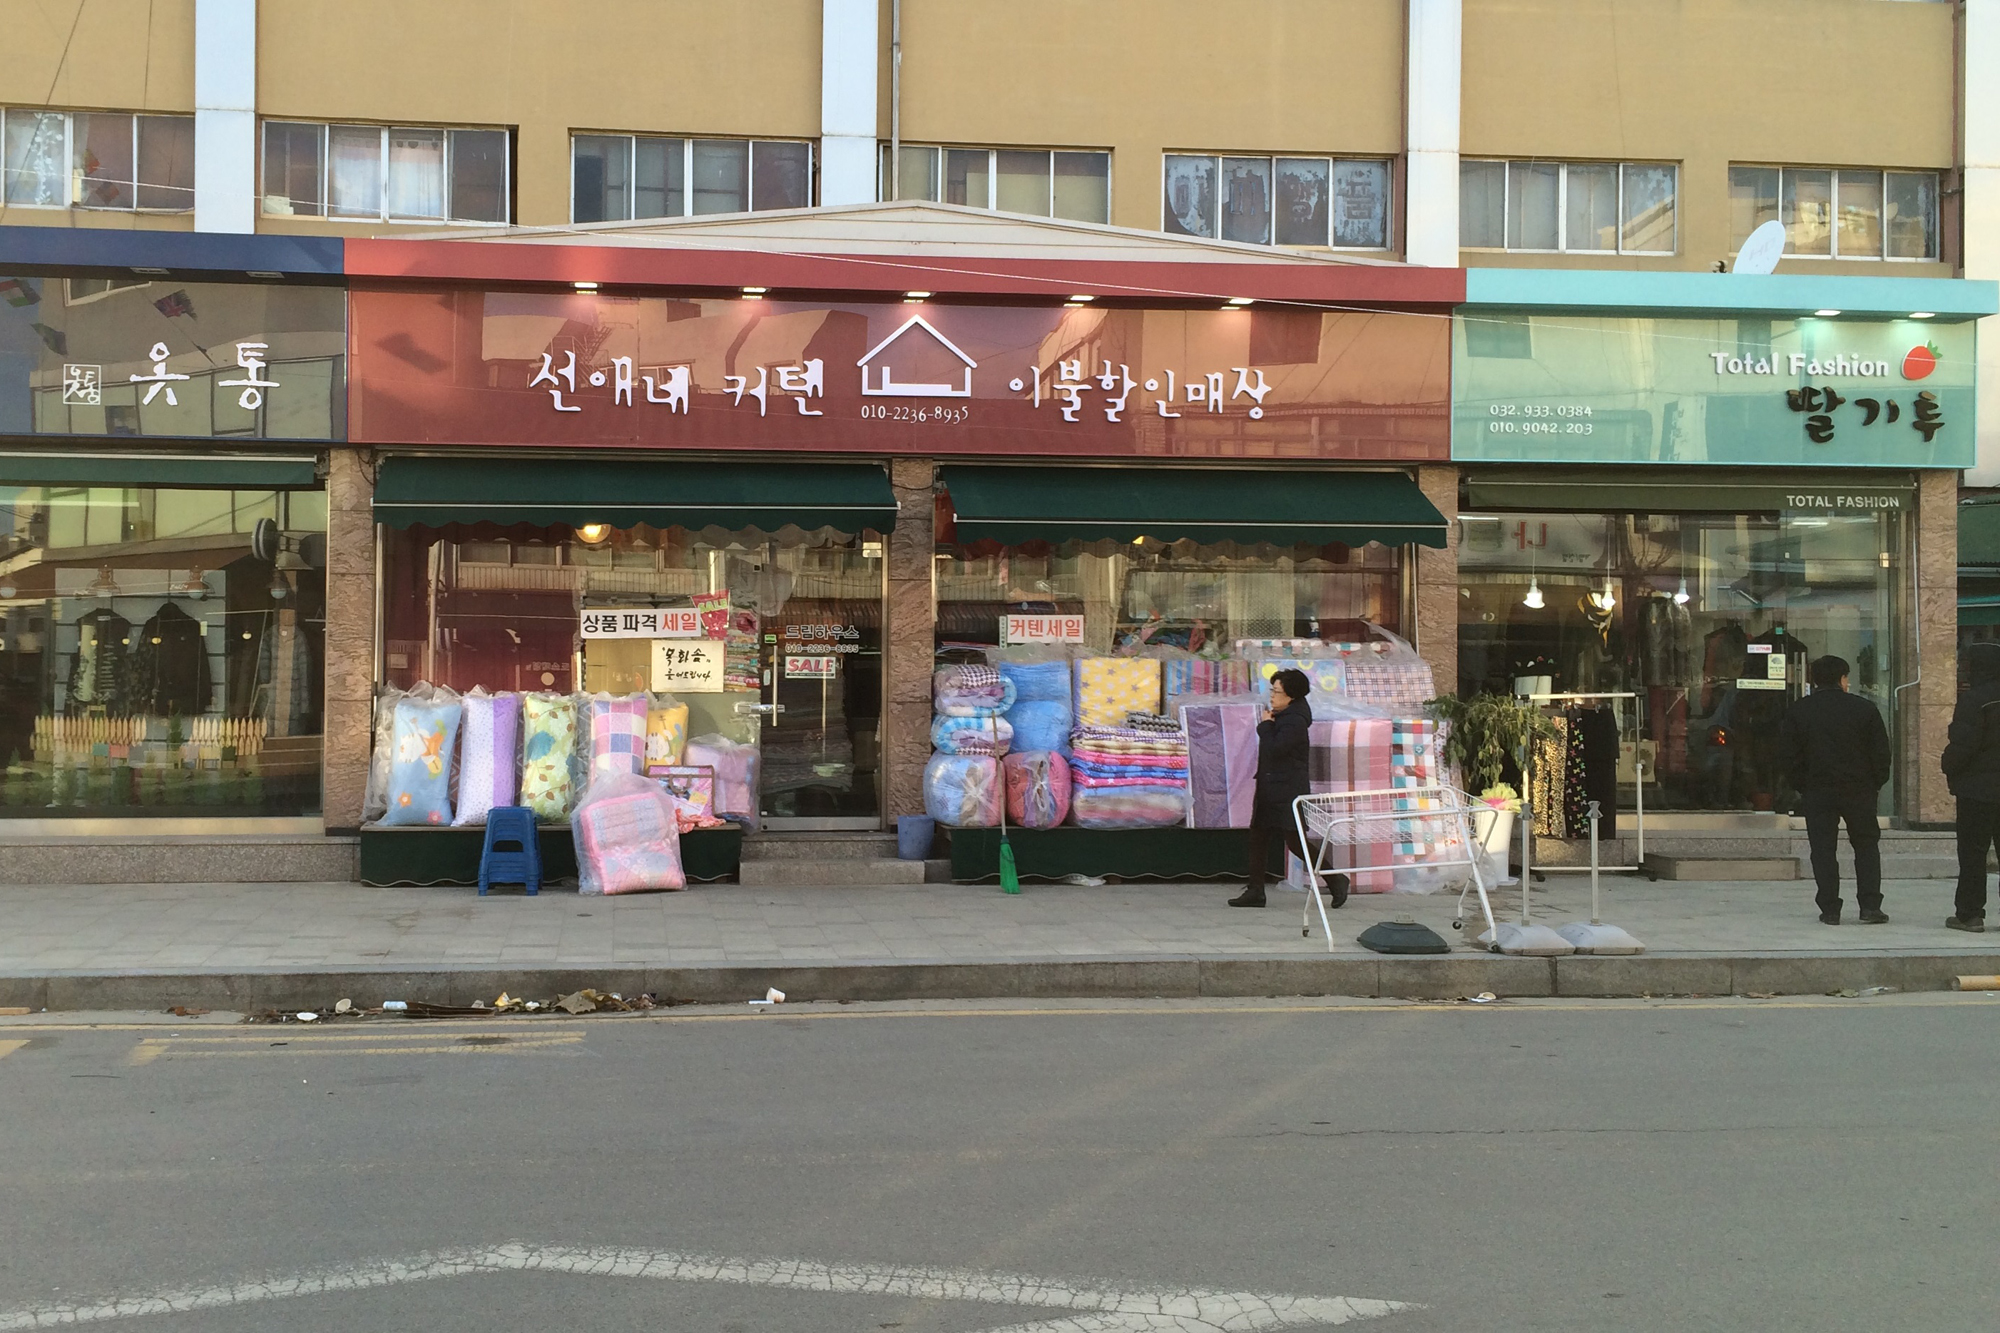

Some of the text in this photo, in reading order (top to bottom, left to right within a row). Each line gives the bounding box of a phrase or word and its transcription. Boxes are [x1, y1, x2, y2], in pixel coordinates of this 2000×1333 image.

[1710, 352, 1890, 377] Total Fashion
[1009, 359, 1272, 423] 이불할인매장
[861, 404, 969, 424] 010-2236-8935
[1786, 495, 1900, 508] TOTAL FASHION
[582, 612, 697, 634] 상품 파격 세일
[785, 624, 860, 640] 드림하우스
[785, 644, 859, 653] 010-2236-8935
[787, 658, 834, 673] SALE
